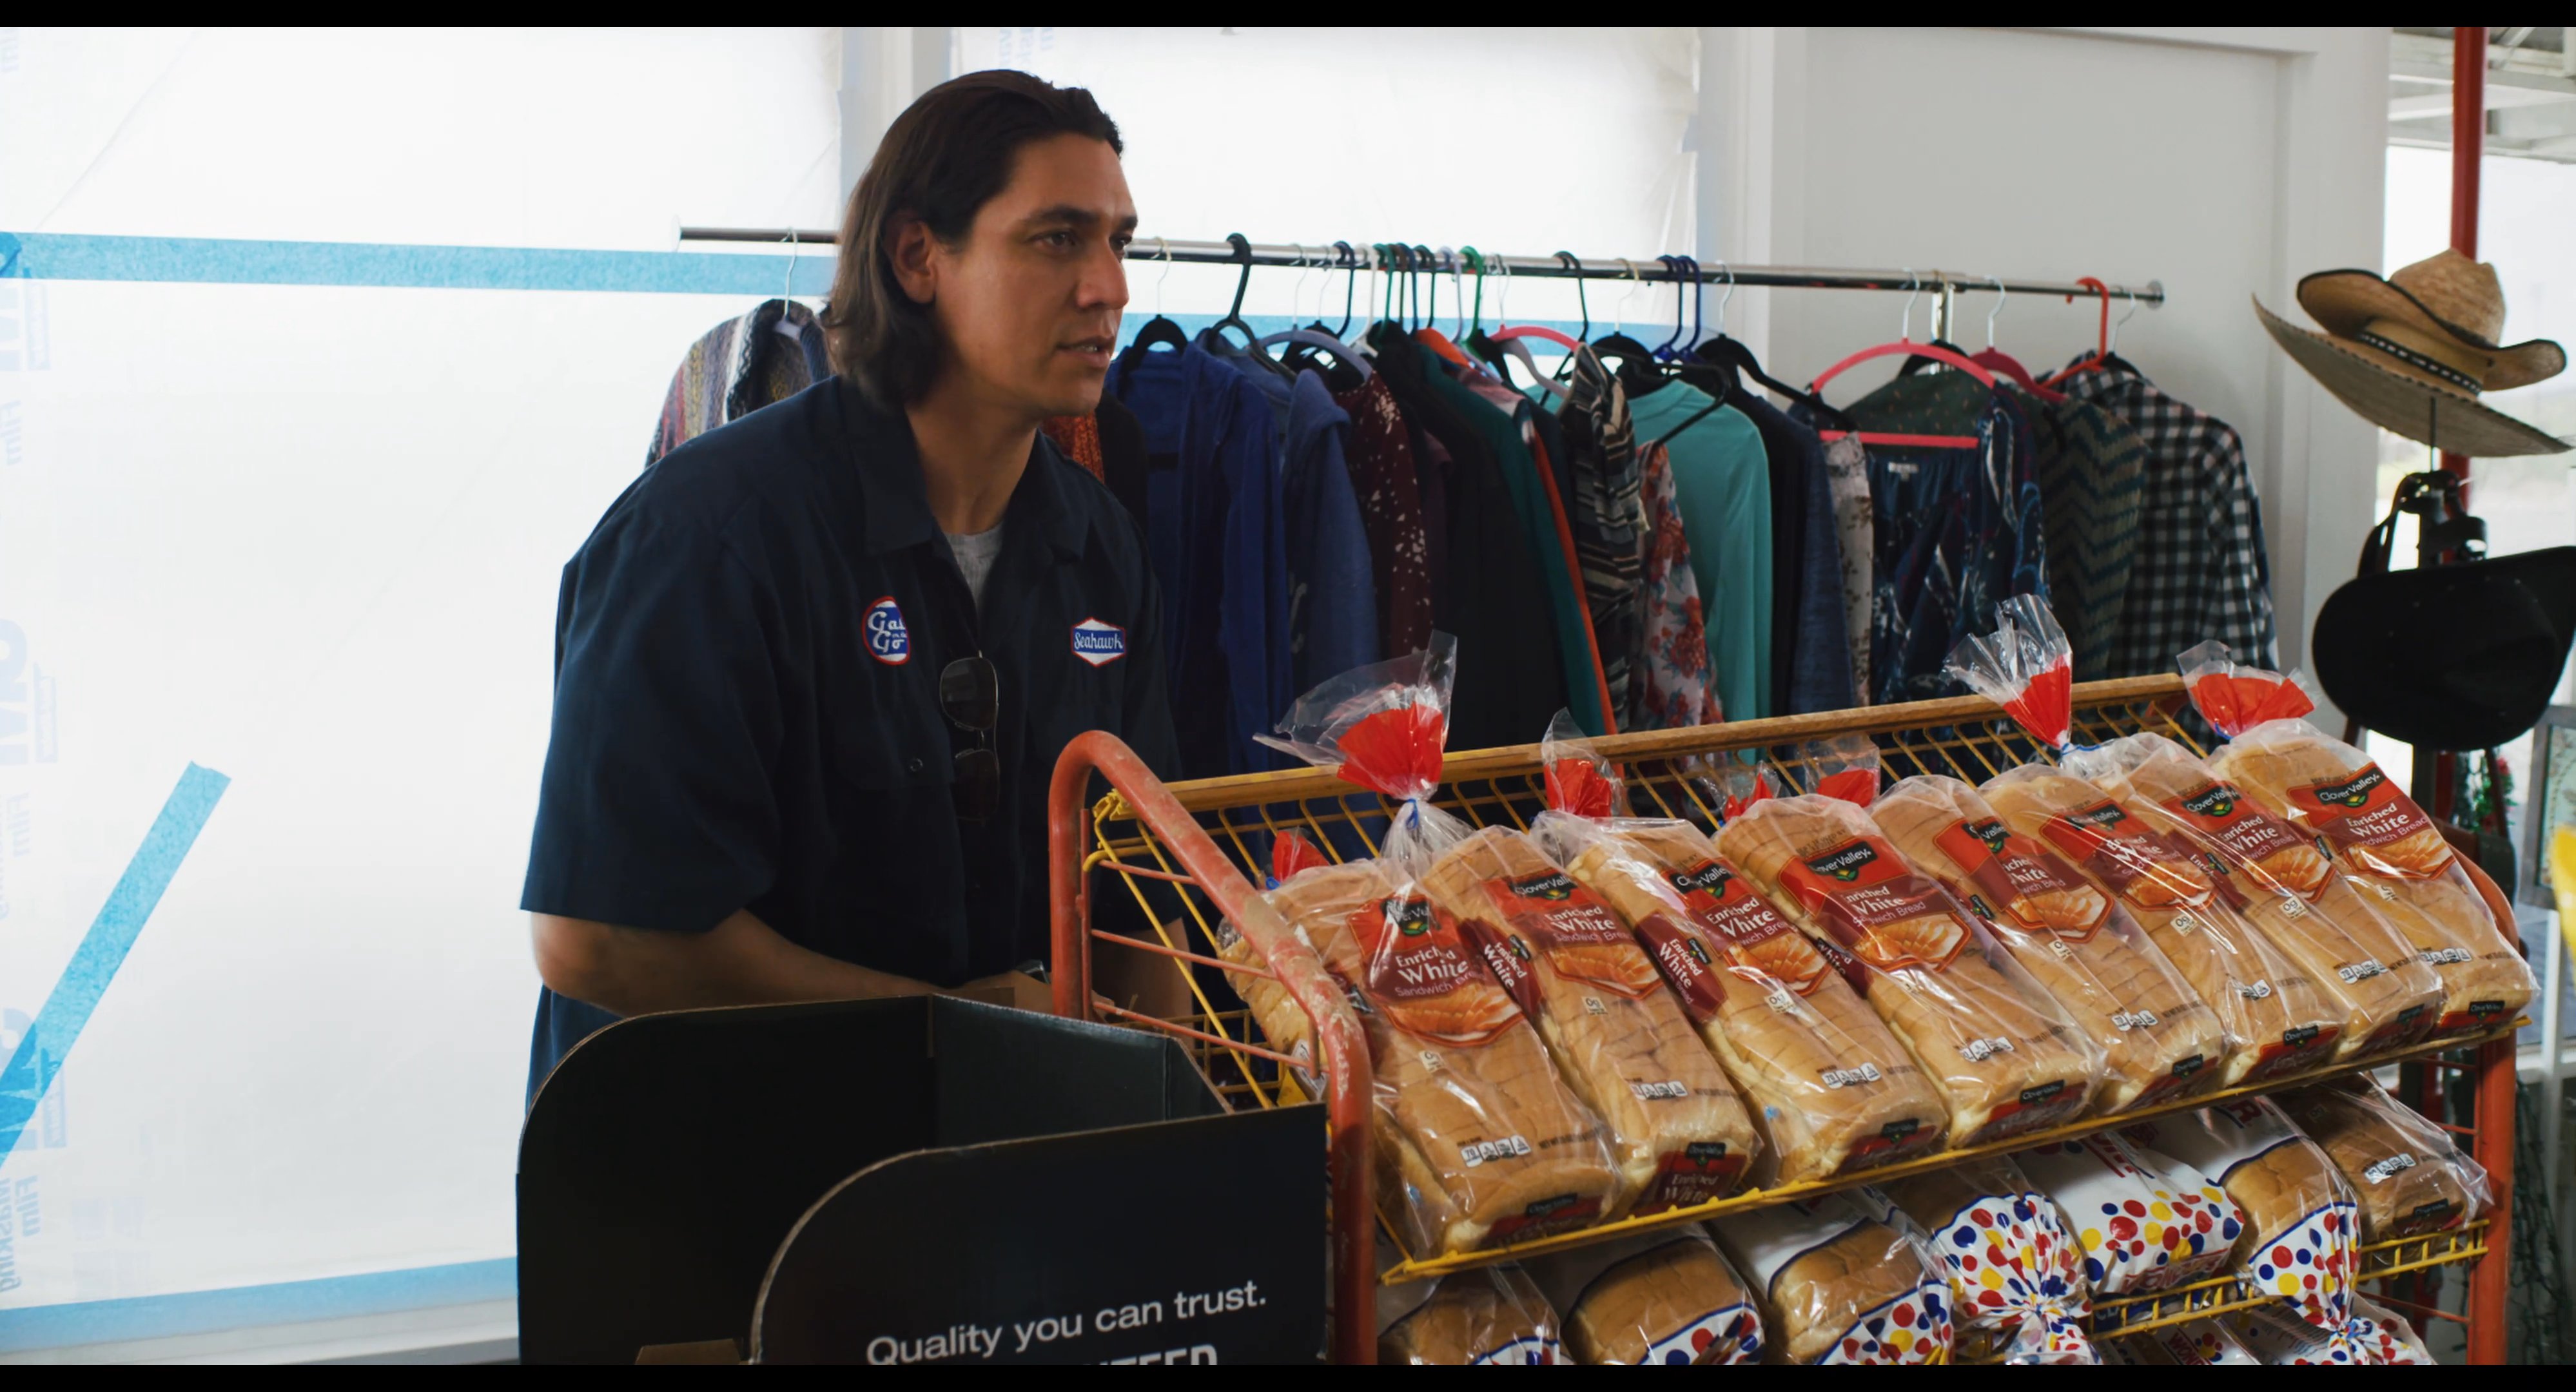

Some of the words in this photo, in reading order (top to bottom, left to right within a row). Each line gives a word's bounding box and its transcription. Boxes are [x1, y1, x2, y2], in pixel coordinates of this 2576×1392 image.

[873, 631, 905, 653] Go
[1074, 632, 1123, 650] Seahawk
[2345, 802, 2397, 827] Enriched
[2350, 813, 2410, 838] White
[1549, 916, 1617, 933] White
[1483, 943, 1515, 989] White
[1659, 943, 1692, 989] White
[1669, 938, 1703, 976] Enriched
[1398, 959, 1469, 985] White
[1394, 980, 1454, 997] Sandwich
[866, 1325, 1002, 1365] Quality
[1014, 1313, 1083, 1352] you
[1095, 1300, 1163, 1333] can
[1173, 1280, 1267, 1320] trust.
